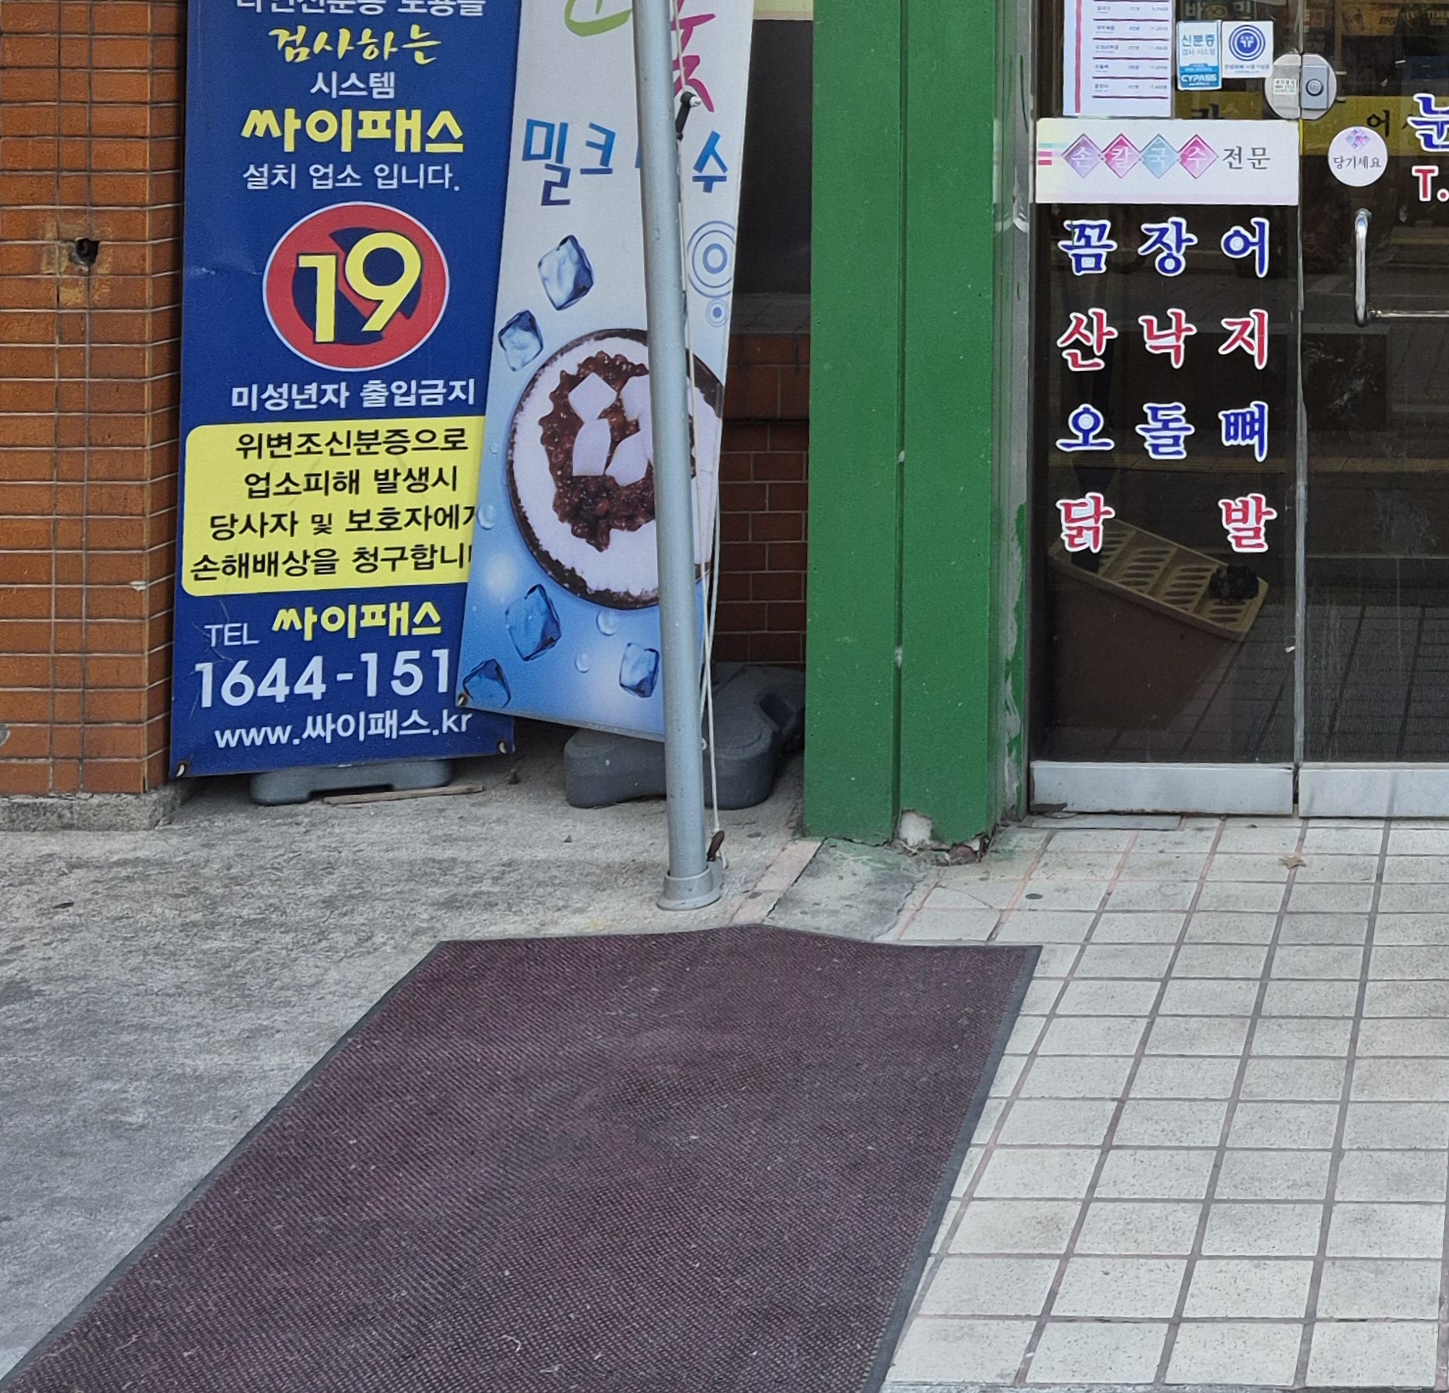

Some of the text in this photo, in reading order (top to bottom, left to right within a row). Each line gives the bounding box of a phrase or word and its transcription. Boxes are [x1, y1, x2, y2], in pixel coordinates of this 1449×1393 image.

[268, 24, 442, 65] 검사하는
[310, 71, 396, 99] 시스템
[241, 108, 464, 153] 싸이패스
[521, 117, 728, 206] 밀크수
[1071, 145, 1271, 170] 손칼국수 전문
[1333, 155, 1382, 171] 당기세요
[242, 164, 461, 192] 설치 업소 입니다.
[1058, 217, 1270, 277] 꼼장어
[297, 231, 423, 344] 19
[1056, 308, 1269, 371] 산낙지
[231, 379, 475, 411] 미성년자 출입금지
[235, 427, 469, 460] 위변조신분증으로
[1056, 401, 1268, 463] 오돌뼈
[244, 465, 458, 499] 업소피해 발생시
[209, 510, 298, 542] 당사자
[310, 513, 333, 535] 및
[190, 543, 472, 582] 손해배상을 청구합니
[204, 601, 443, 648] TEL 싸이패스
[195, 649, 450, 708] 1644-151
[215, 709, 472, 749] www.싸이패스.kr
